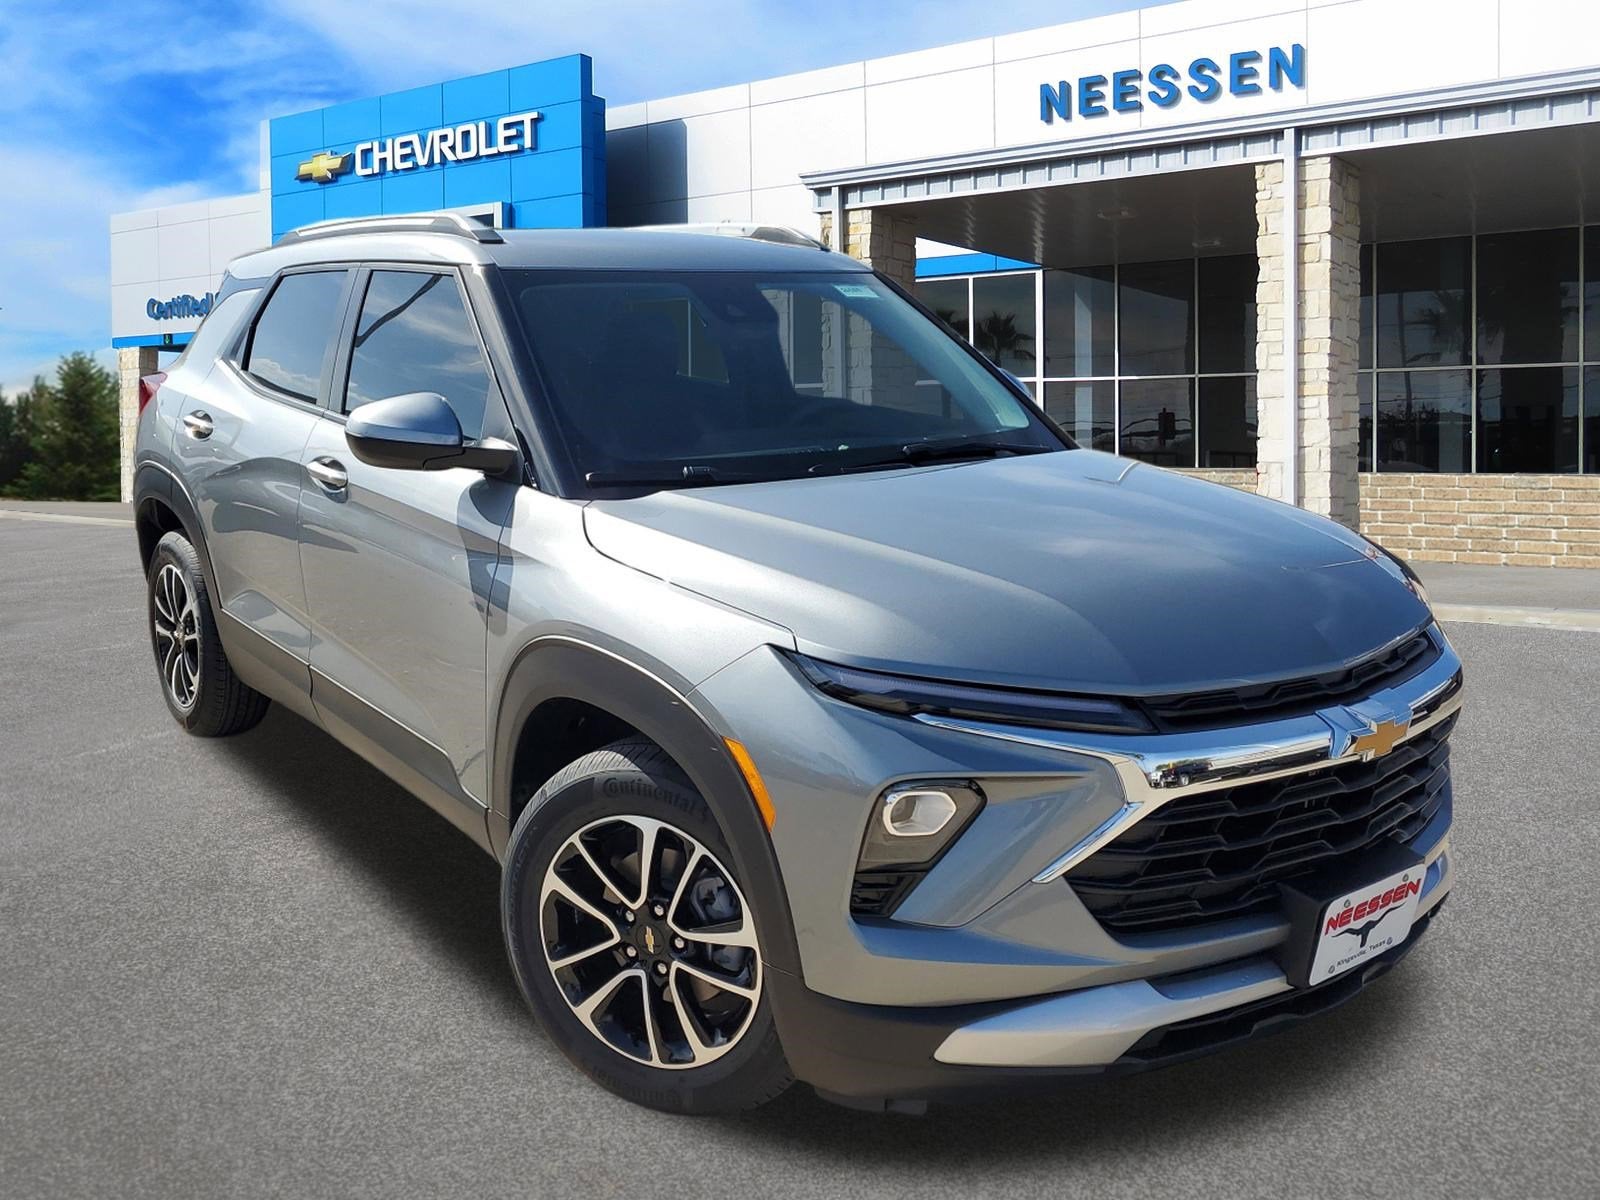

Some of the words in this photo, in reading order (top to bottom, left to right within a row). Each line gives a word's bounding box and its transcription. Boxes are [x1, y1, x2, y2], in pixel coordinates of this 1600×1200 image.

[1040, 43, 1305, 125] NEESSEN
[354, 111, 543, 177] CHEVROLET
[146, 292, 214, 321] Certified
[603, 777, 697, 817] Continental
[1324, 878, 1422, 936] NEESSEN
